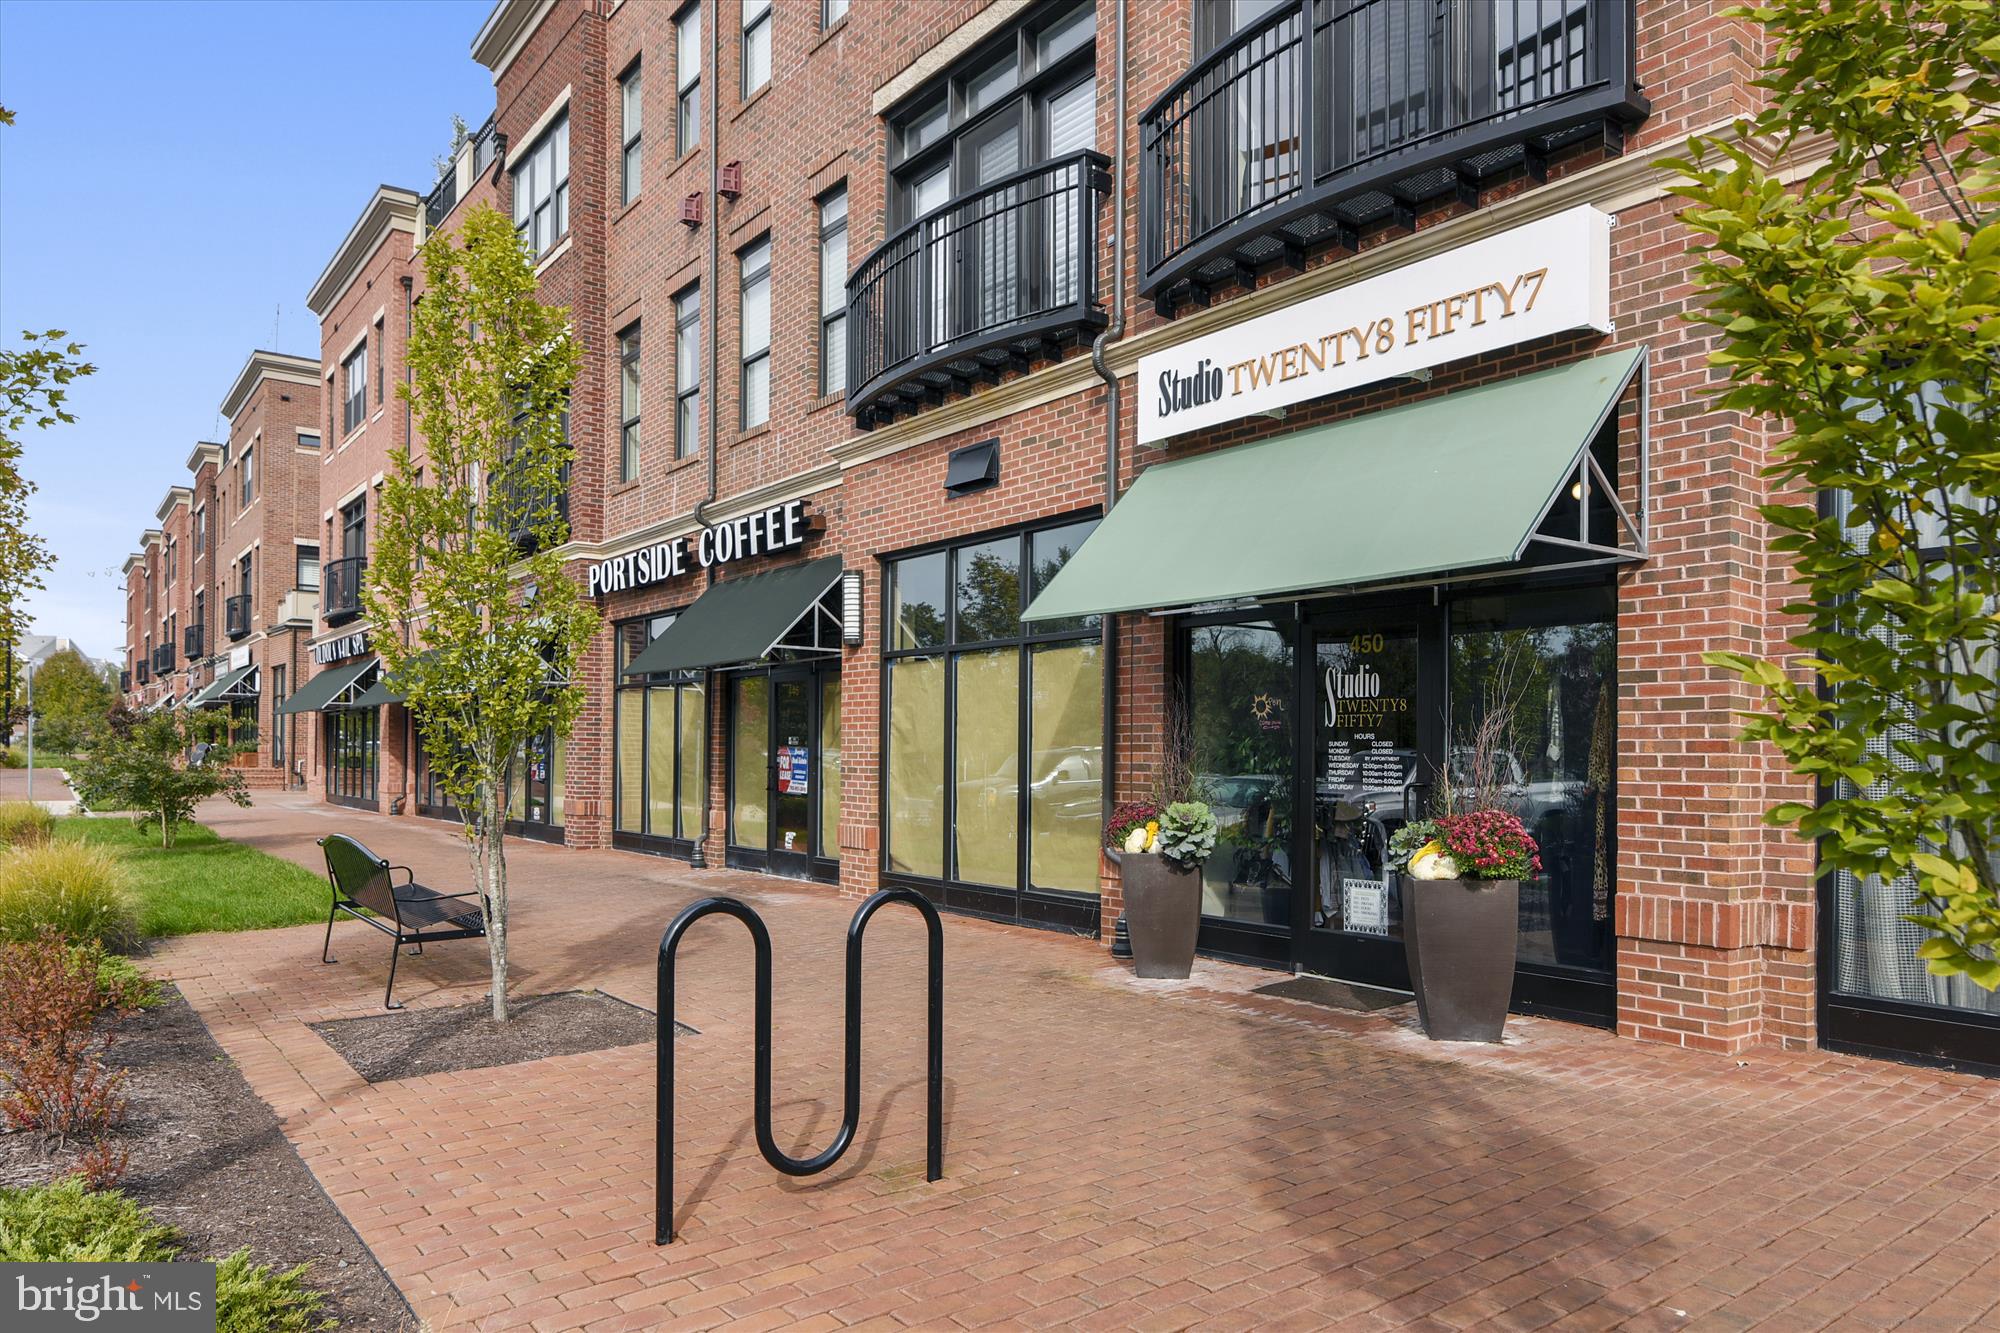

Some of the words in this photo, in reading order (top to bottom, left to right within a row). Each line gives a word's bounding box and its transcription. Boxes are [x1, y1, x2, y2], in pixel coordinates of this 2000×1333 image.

[1158, 358, 1223, 418] Studio
[1227, 317, 1395, 397] TWENTY8
[1404, 267, 1549, 346] FIFTY7
[589, 537, 686, 598] PORTSIDE
[699, 501, 803, 568] COFFEE
[352, 632, 365, 656] SPA
[1352, 633, 1384, 653] 450
[1325, 664, 1380, 727] Studio
[1336, 698, 1407, 713] TWENTY8
[1336, 713, 1384, 728] FIFTY7
[780, 755, 790, 769] FOR
